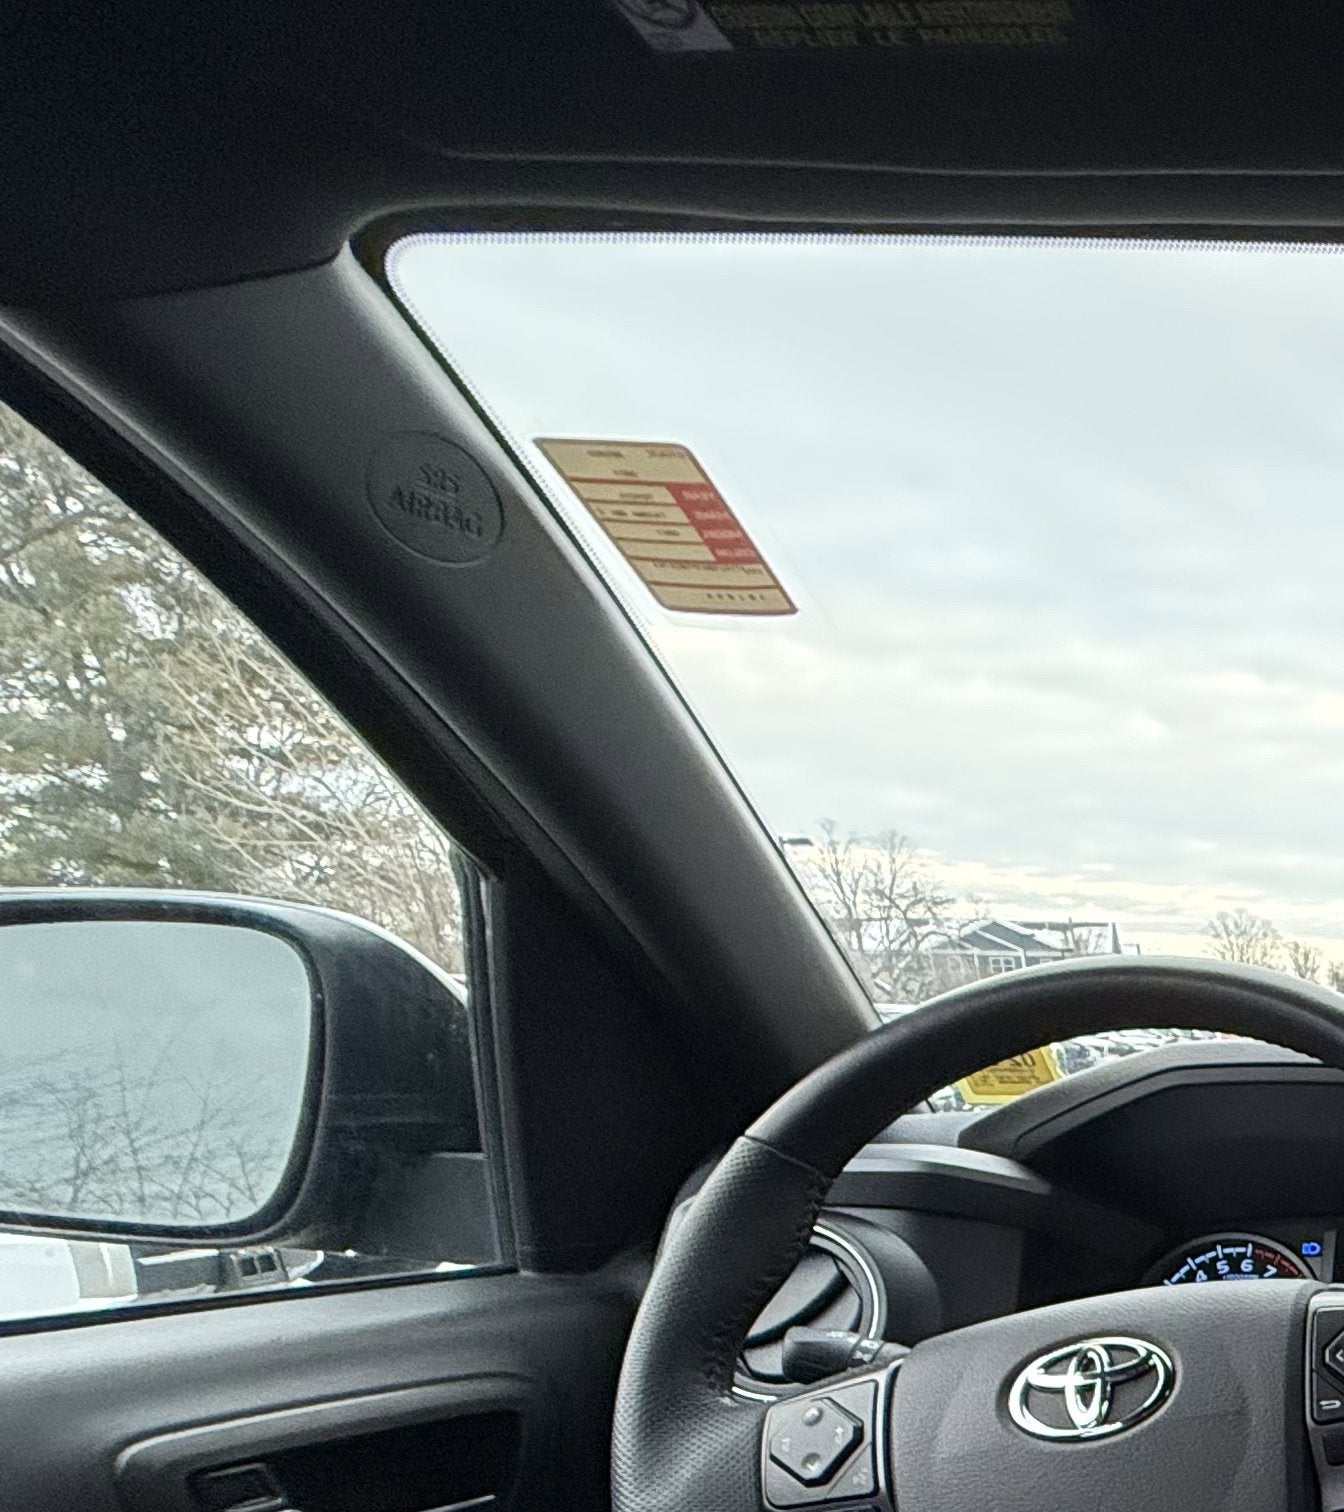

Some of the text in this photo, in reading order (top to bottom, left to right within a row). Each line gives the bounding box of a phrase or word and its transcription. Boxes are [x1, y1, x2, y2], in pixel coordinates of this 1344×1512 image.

[1216, 1260, 1230, 1275] 5
[1240, 1259, 1254, 1273] 6
[1263, 1264, 1278, 1278] 7
